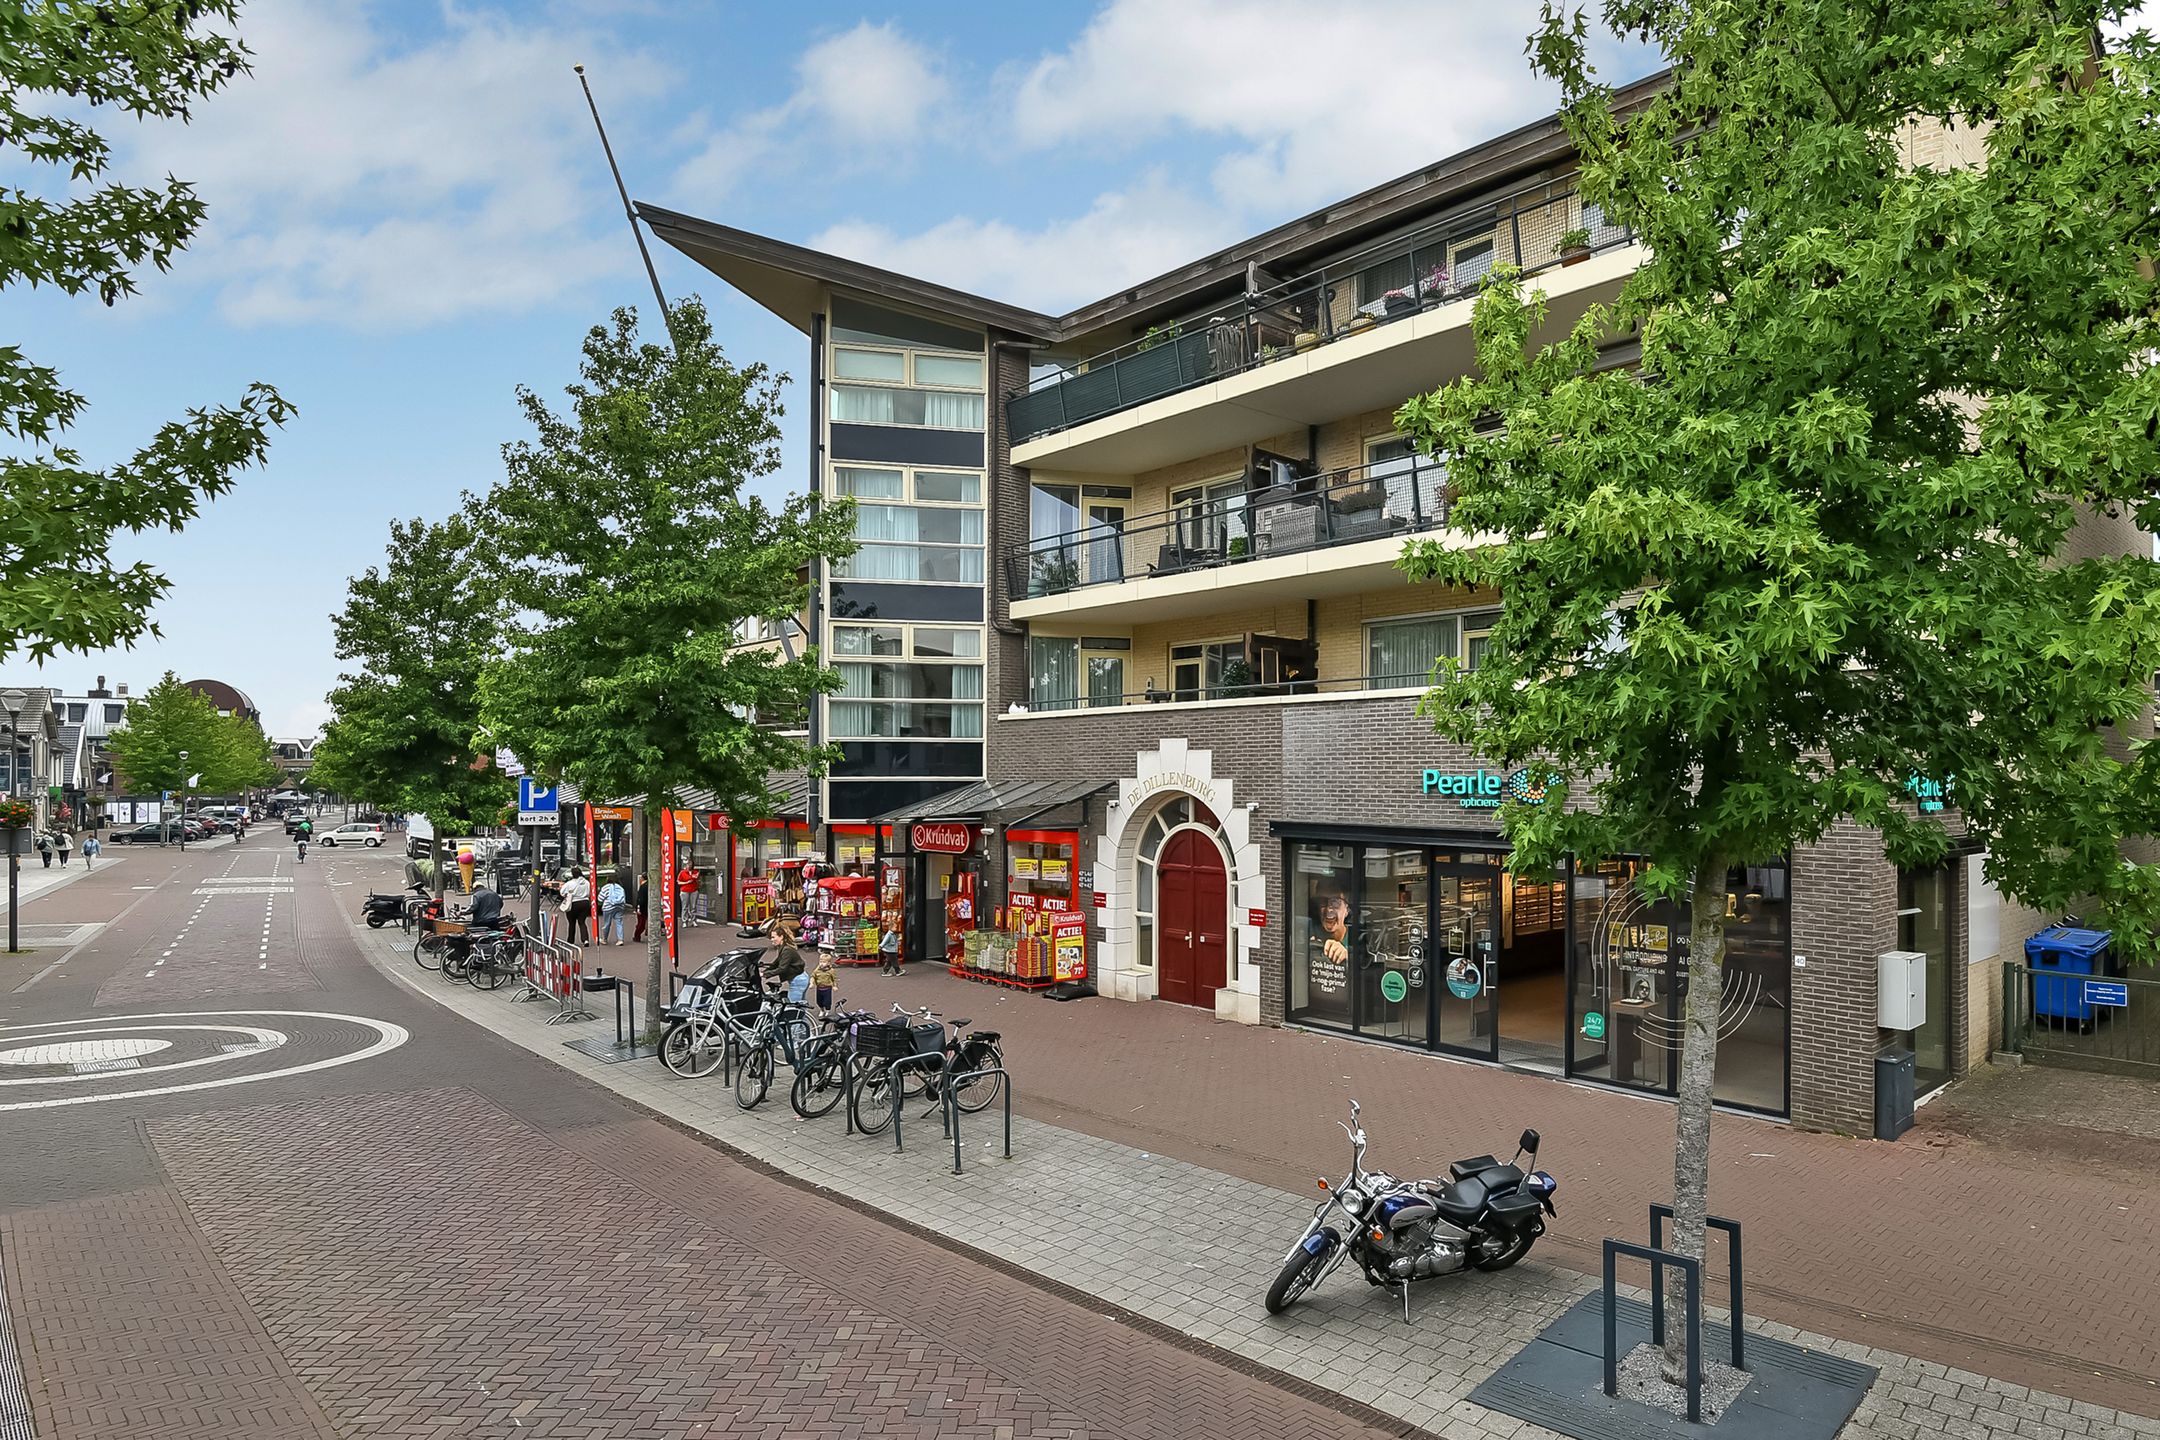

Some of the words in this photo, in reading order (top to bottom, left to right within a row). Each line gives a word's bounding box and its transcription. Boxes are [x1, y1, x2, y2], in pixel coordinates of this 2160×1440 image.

[1423, 768, 1502, 795] Pearle
[528, 781, 549, 808] P
[1127, 787, 1142, 807] DE
[1142, 772, 1216, 802] DILLENBURG
[1460, 798, 1501, 808] opticiens
[925, 828, 965, 847] Kruidvat
[1012, 894, 1035, 907] ACTIE!
[1042, 898, 1067, 912] ACTIE!
[1056, 926, 1082, 938] ACTIE!
[1312, 960, 1323, 968] Ook
[1323, 962, 1334, 970] last
[1795, 957, 1804, 965] 40
